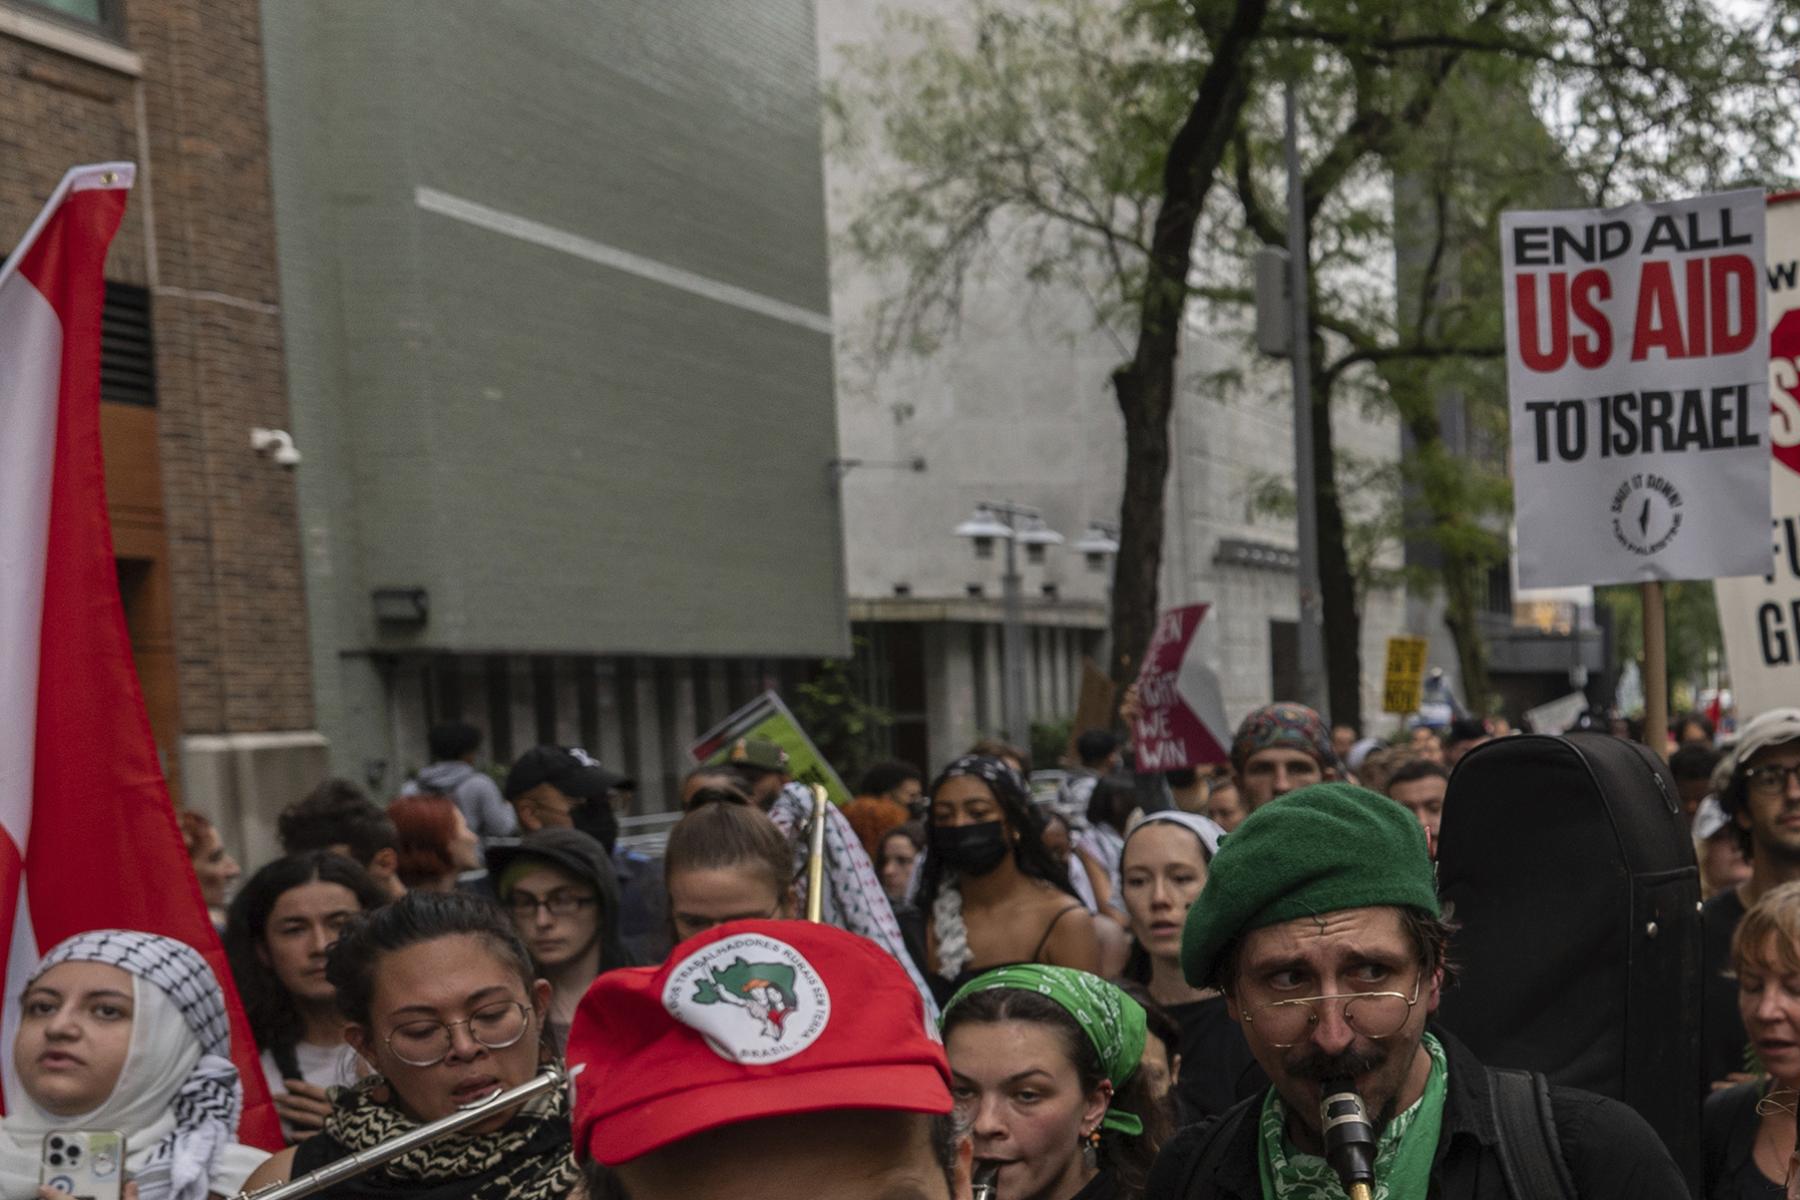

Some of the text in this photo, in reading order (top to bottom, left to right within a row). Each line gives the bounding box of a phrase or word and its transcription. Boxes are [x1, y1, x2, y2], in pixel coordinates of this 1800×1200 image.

[1513, 208, 1753, 266] END ALL
[1516, 253, 1758, 374] US AID
[1525, 384, 1760, 464] TO ISRAEL
[1611, 480, 1632, 513] SHUT
[1137, 738, 1188, 770] WIN
[675, 937, 782, 986] TRABALHADORES
[782, 949, 818, 986] RURAIS
[800, 1007, 827, 1041] TERRA
[739, 1042, 793, 1059] BRASIL
